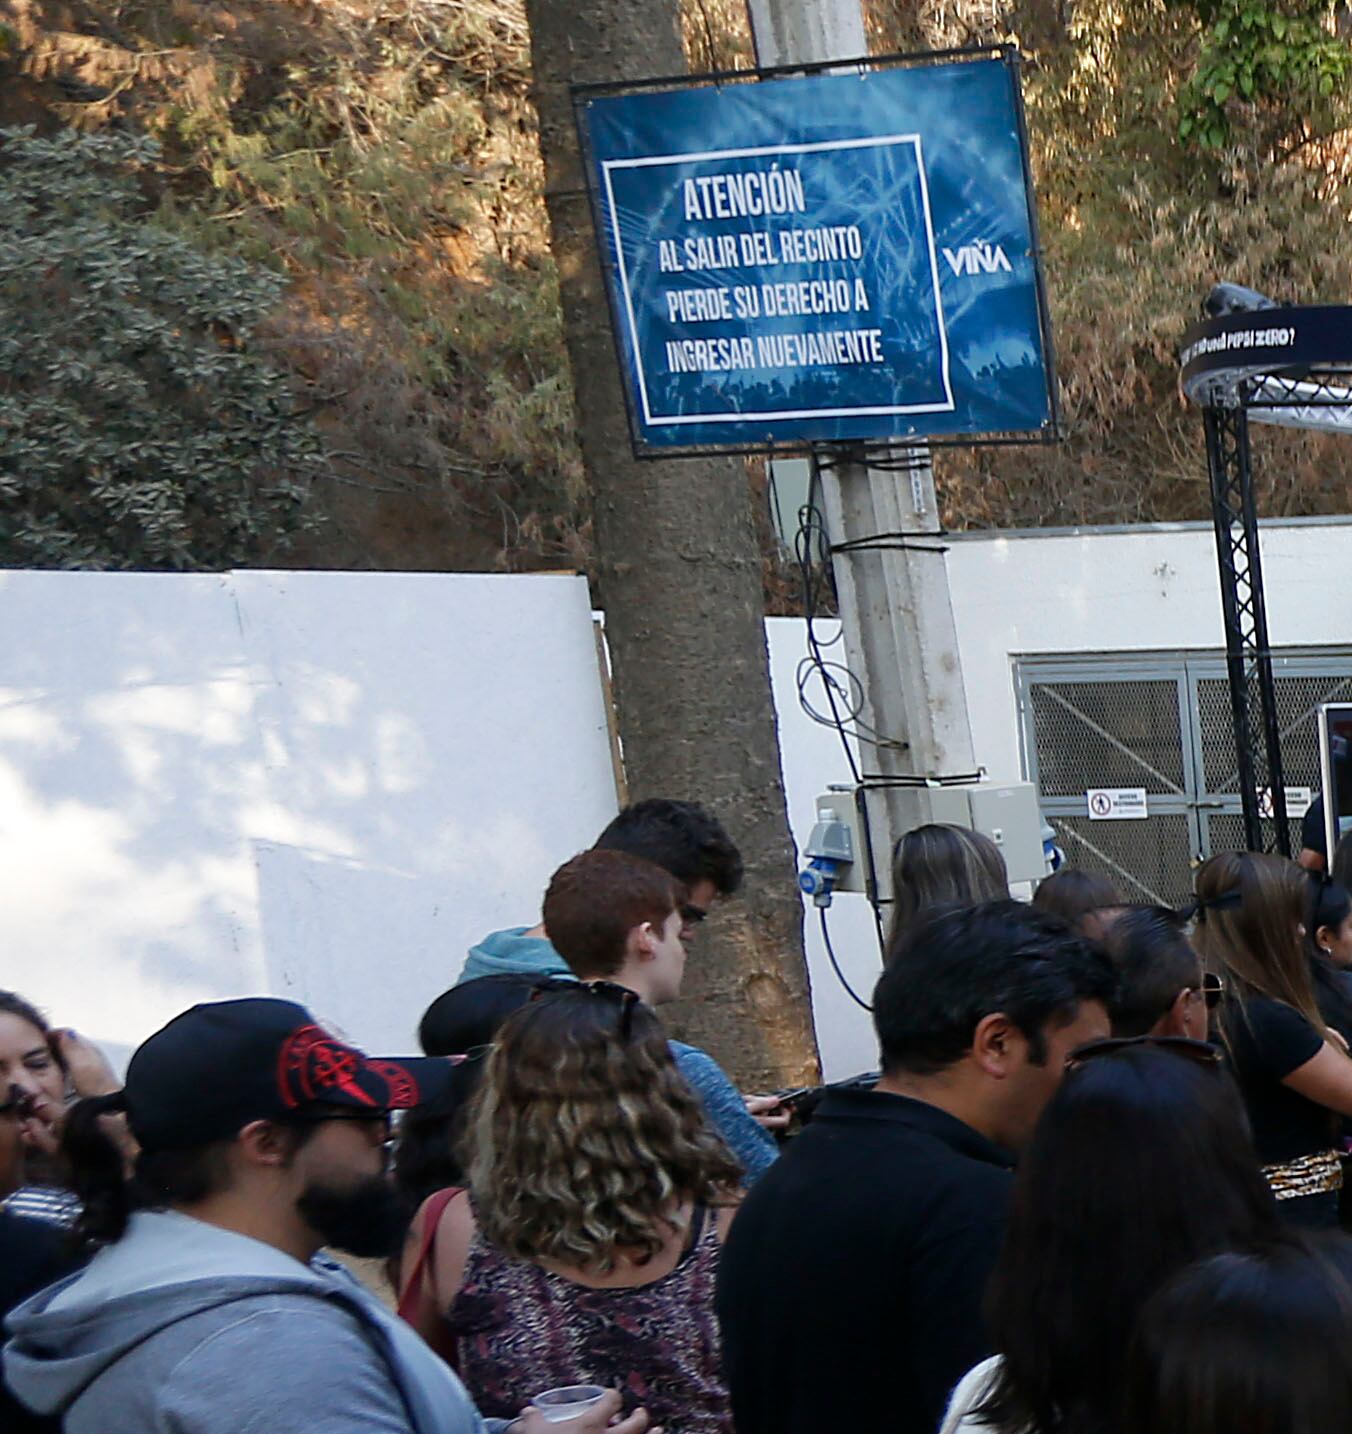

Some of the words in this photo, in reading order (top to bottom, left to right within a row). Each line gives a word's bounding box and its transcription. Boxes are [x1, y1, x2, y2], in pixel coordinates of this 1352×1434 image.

[683, 162, 806, 221] ATENCIÓN
[659, 240, 684, 273] AL
[684, 233, 738, 270] SALIR
[740, 232, 777, 267] DEL
[780, 226, 863, 263] RECINTO
[666, 290, 732, 323] PIERDE
[734, 287, 760, 318] SU
[762, 279, 847, 317] DERECHO
[854, 278, 870, 312] A
[666, 340, 755, 373] INGRESAR
[757, 330, 885, 369] NUEVAMENTE
[1255, 327, 1295, 347] ZERO?
